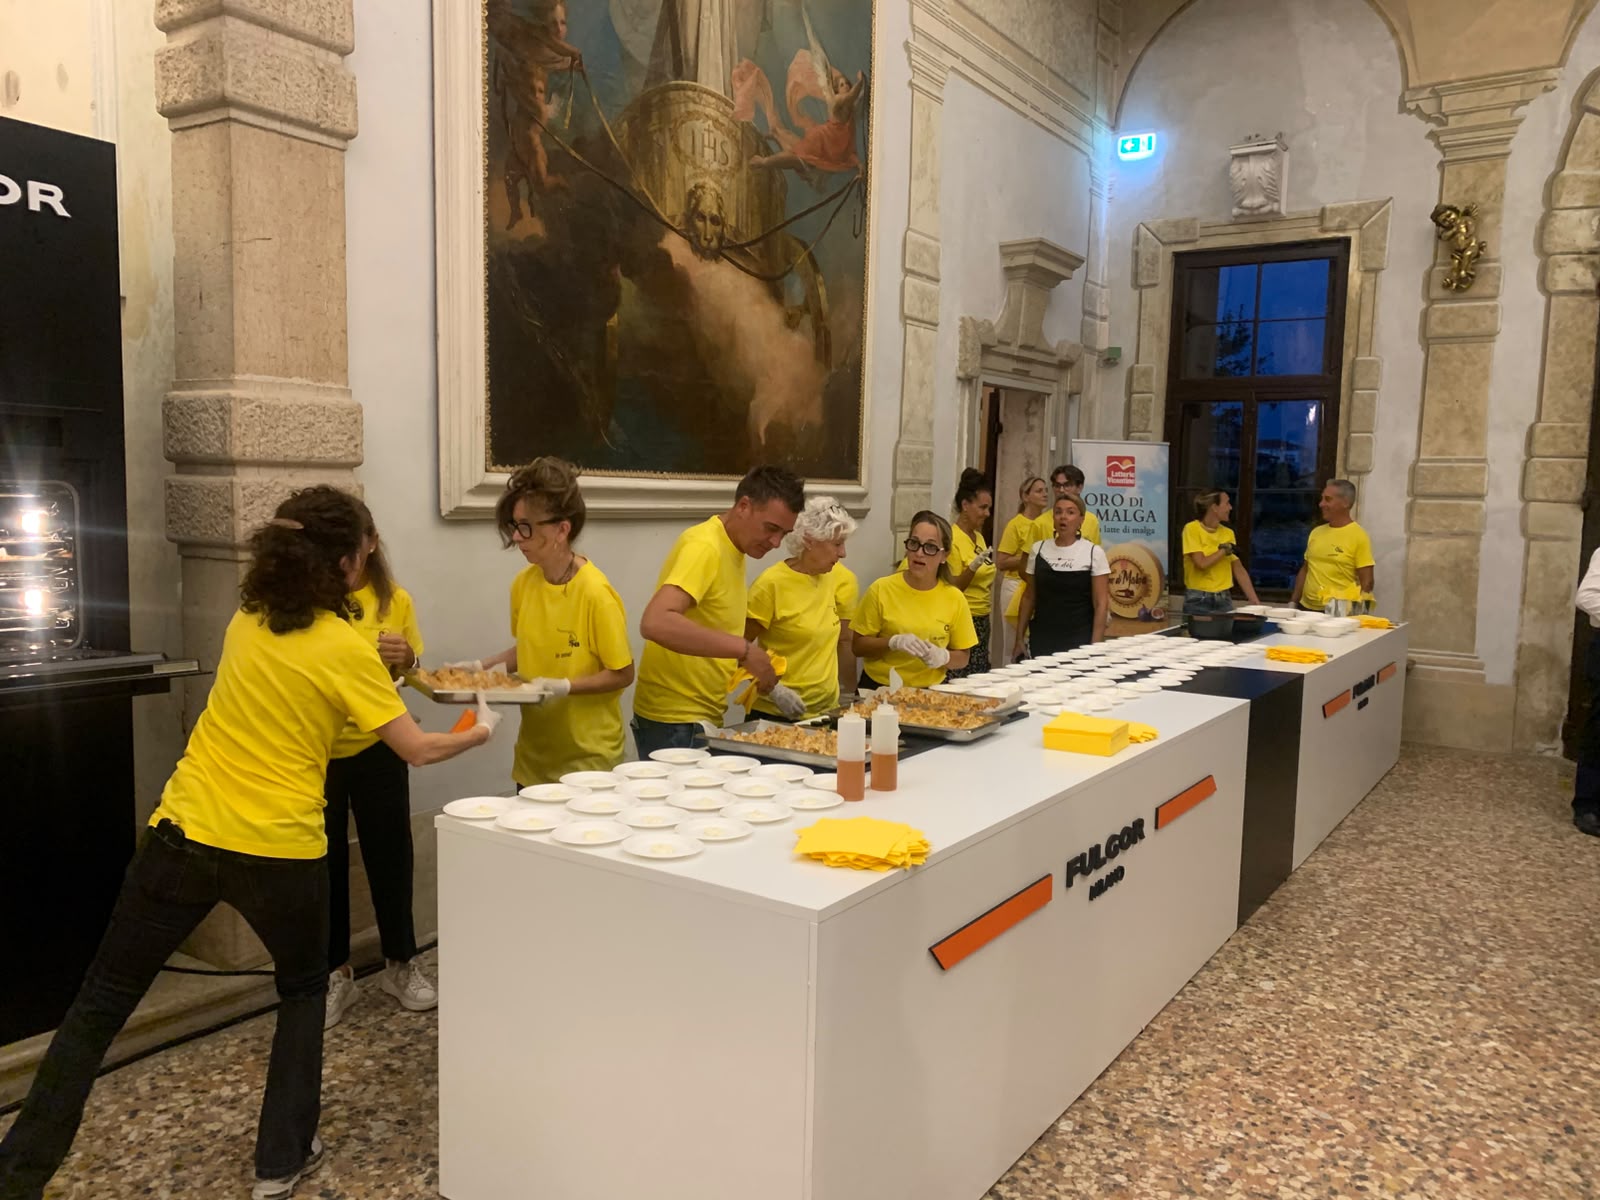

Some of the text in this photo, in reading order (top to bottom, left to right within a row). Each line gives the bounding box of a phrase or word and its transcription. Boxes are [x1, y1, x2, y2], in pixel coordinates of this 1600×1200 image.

[1084, 492, 1143, 508] ORO DI
[1096, 508, 1157, 523] MALGA
[1104, 525, 1120, 534] latte
[1122, 525, 1130, 534] di
[1132, 526, 1155, 537] malga
[1066, 817, 1146, 888] FULGOR
